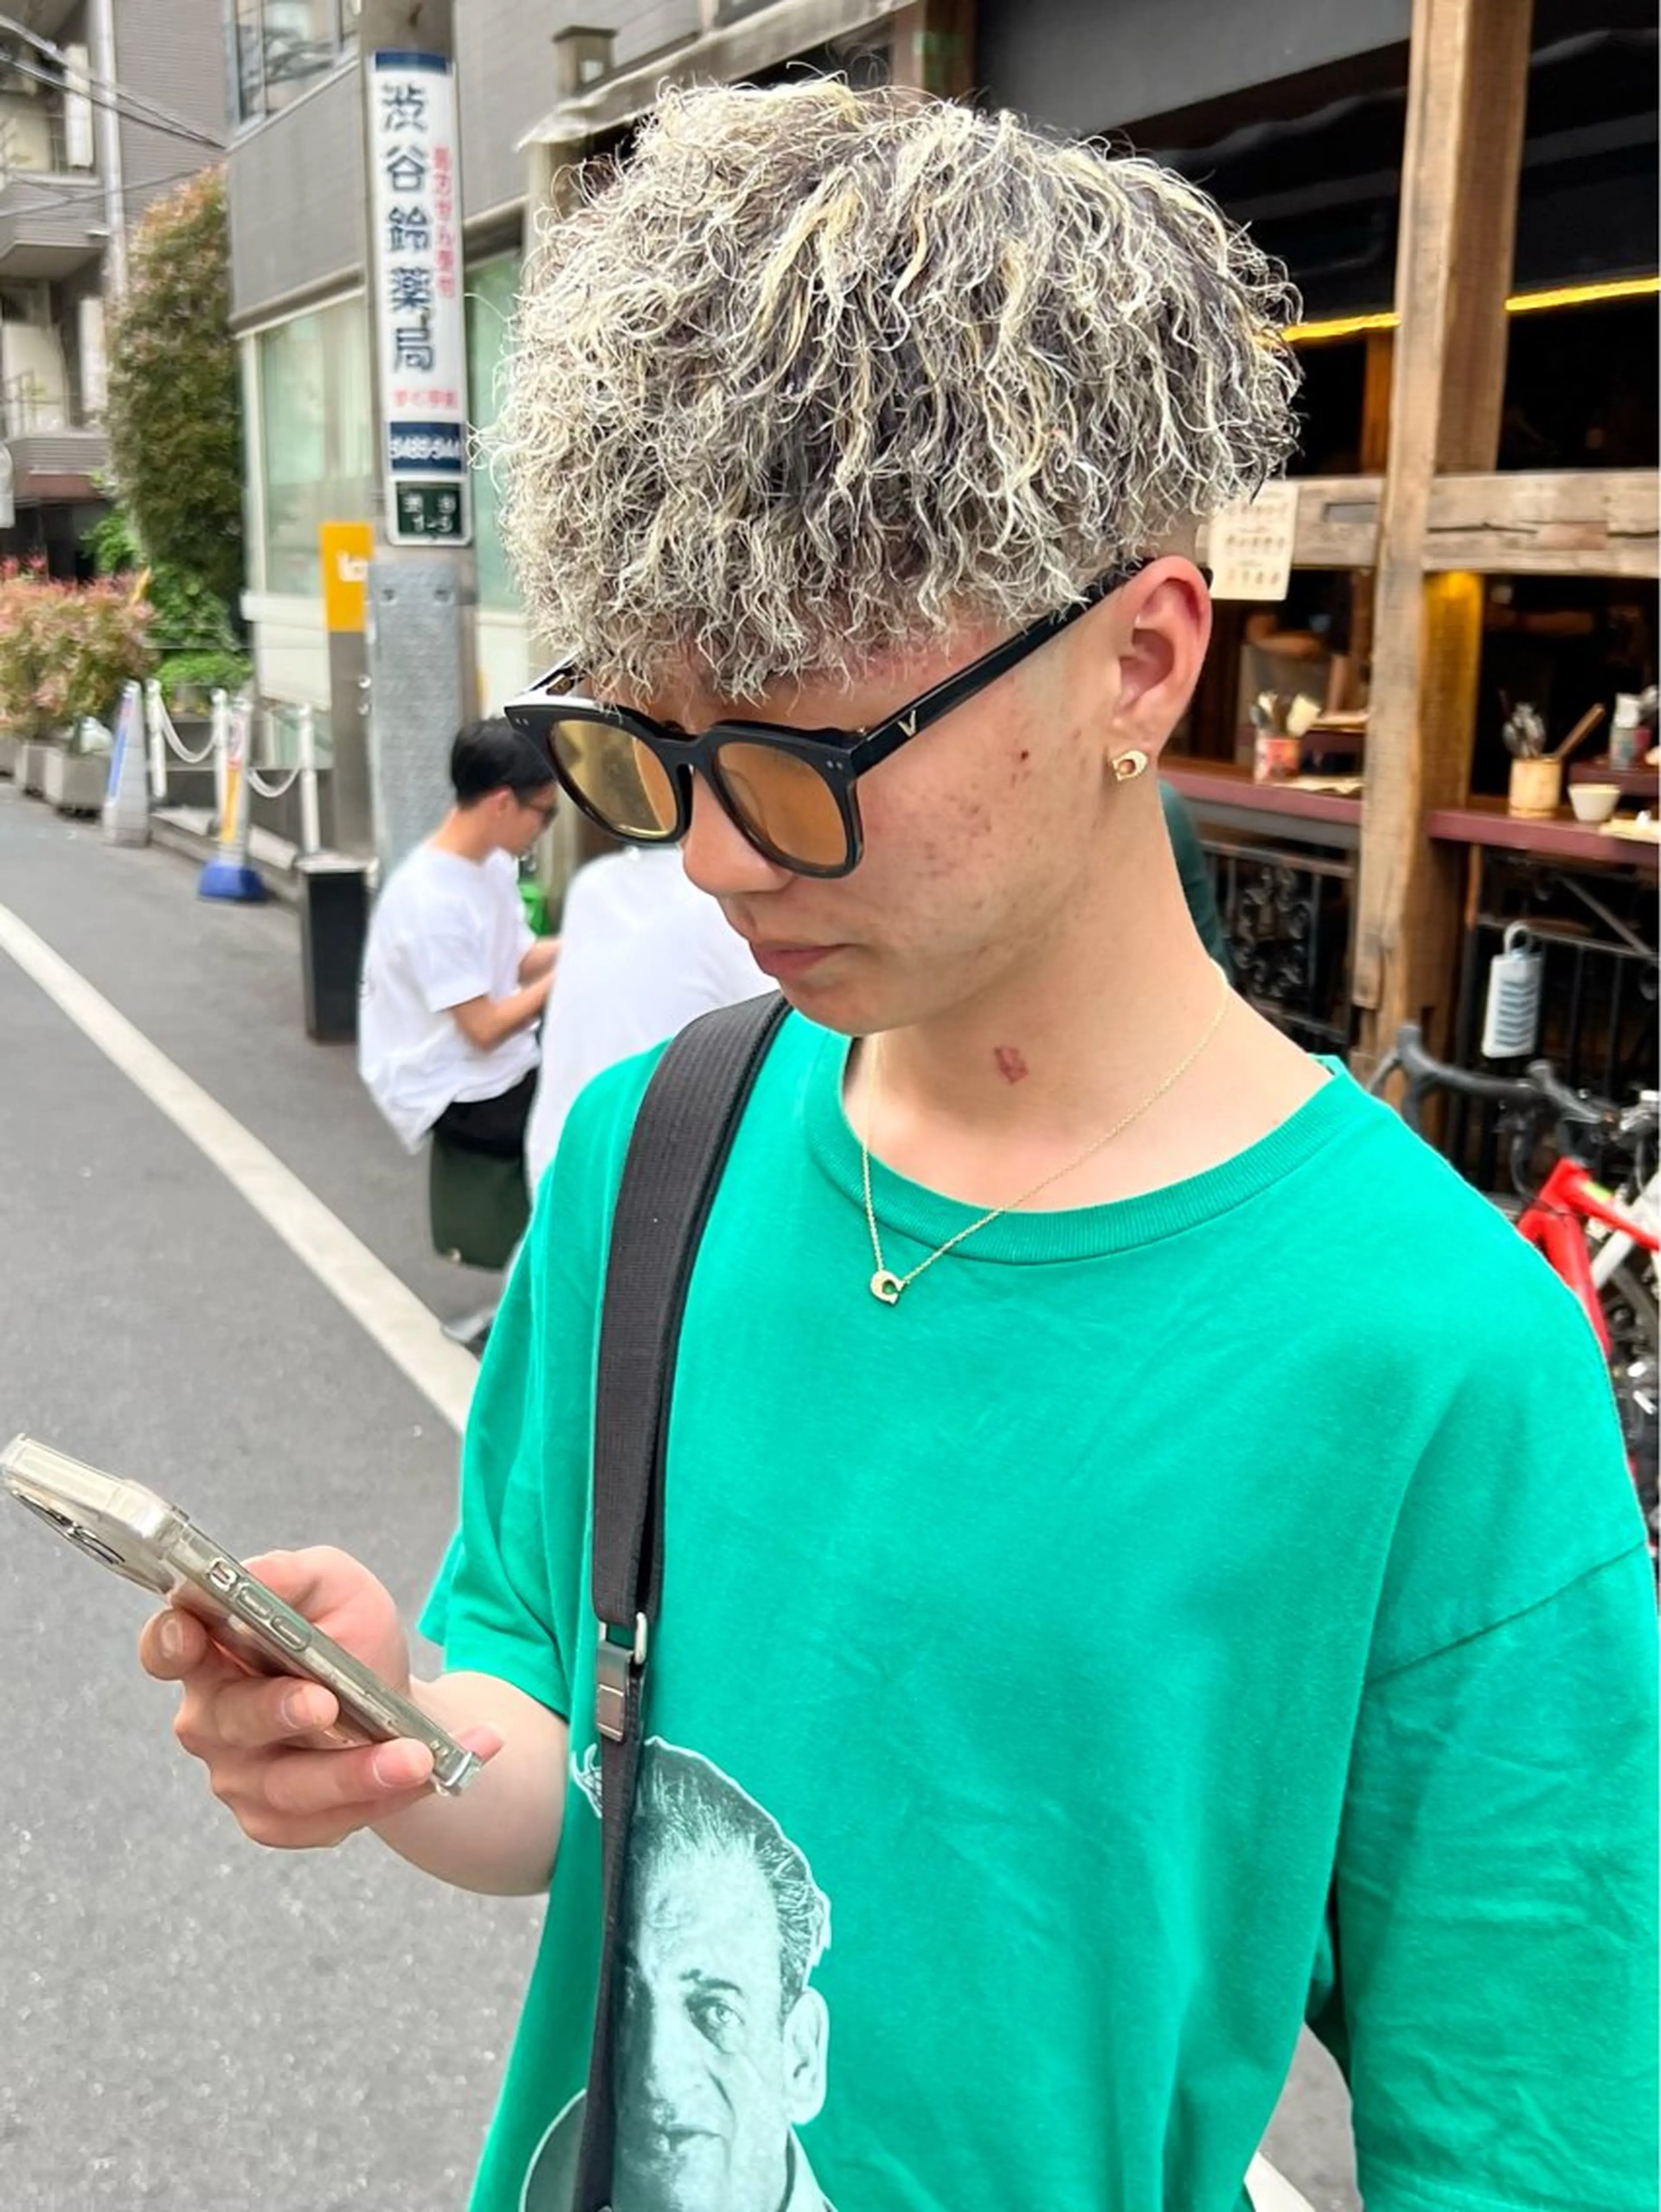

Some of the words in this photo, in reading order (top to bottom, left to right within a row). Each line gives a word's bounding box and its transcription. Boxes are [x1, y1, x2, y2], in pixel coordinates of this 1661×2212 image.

[382, 84, 434, 372] 渋谷鈴薬局
